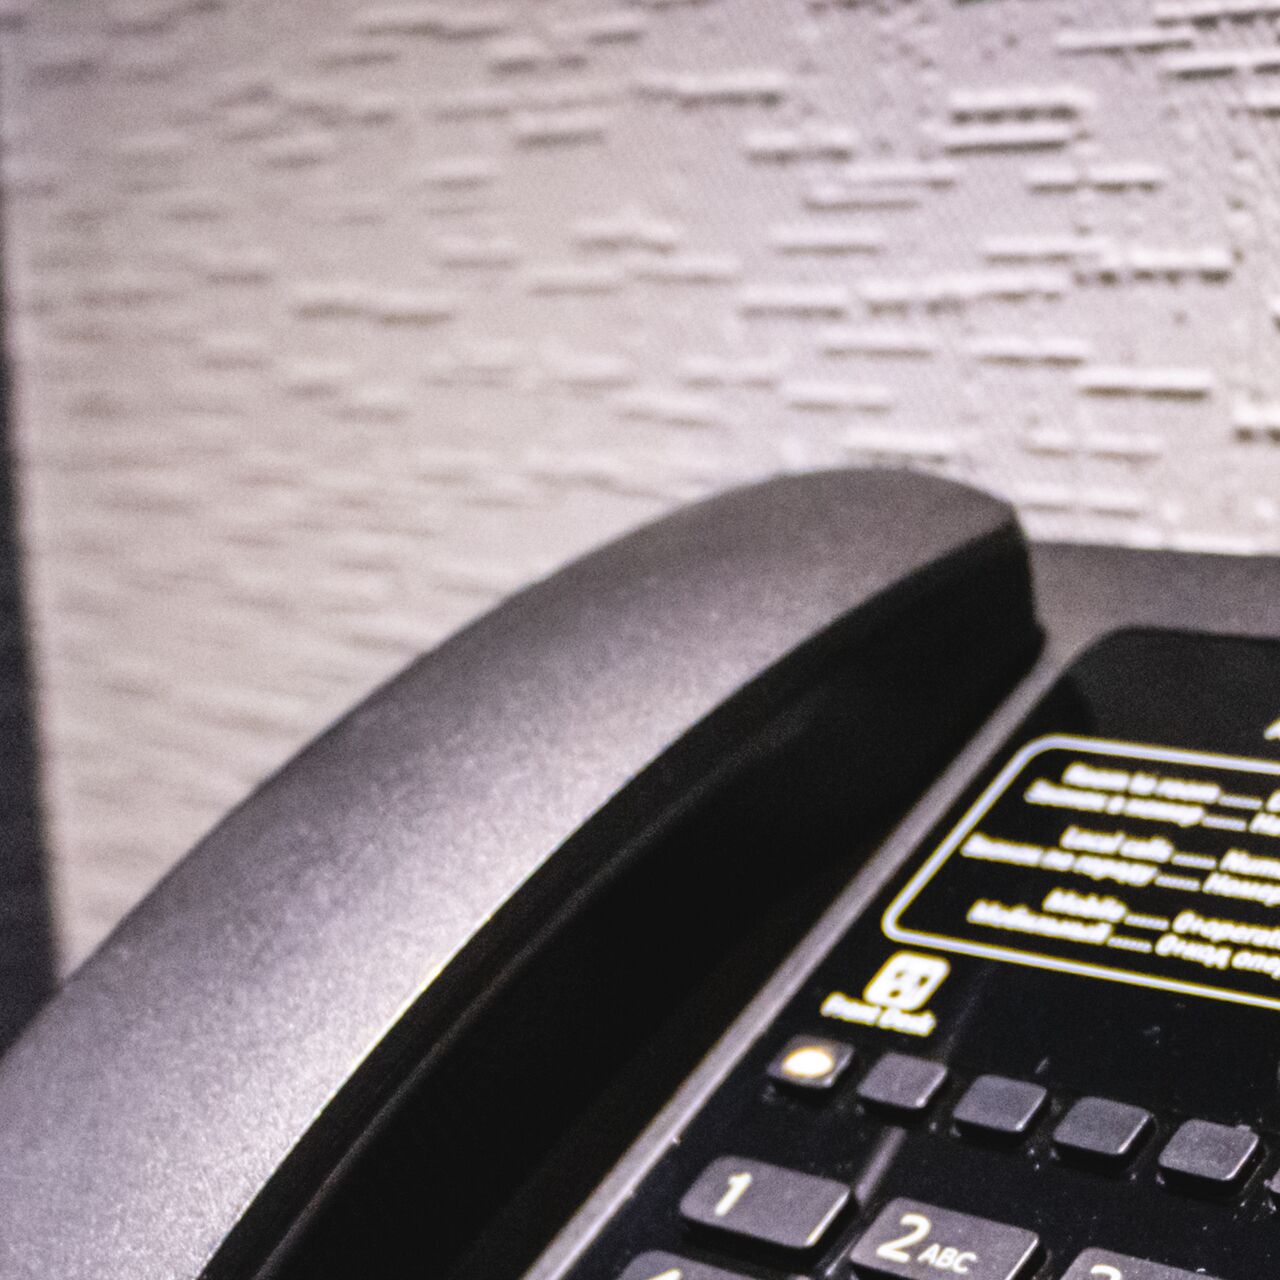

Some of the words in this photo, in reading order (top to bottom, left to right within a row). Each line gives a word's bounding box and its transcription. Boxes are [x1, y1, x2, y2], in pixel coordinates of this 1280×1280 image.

[1154, 933, 1233, 970] 0+код
[713, 1172, 752, 1217] 1
[876, 1214, 931, 1264] 2
[918, 1243, 978, 1275] ABC
